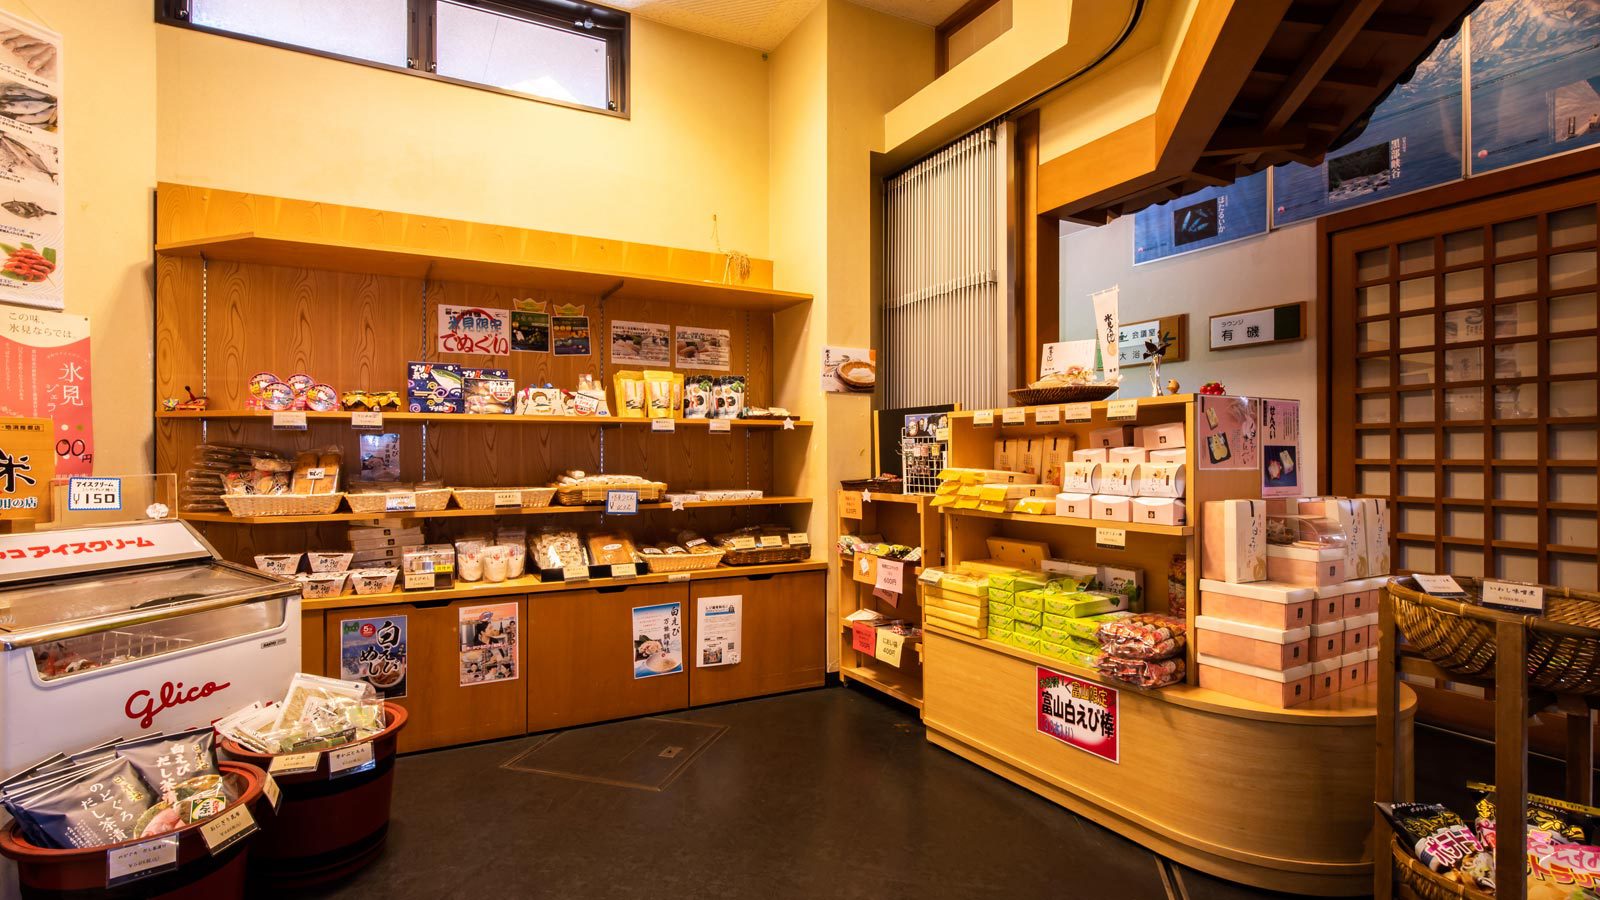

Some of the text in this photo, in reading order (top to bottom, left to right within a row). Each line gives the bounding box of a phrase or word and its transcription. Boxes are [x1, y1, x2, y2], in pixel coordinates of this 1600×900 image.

[1391, 139, 1400, 179] 黒部峡谷
[1132, 328, 1156, 340] 会議室
[1221, 319, 1244, 327] ラウンジ
[58, 362, 84, 406] 氷見
[28, 536, 155, 559] アイスクリーム
[671, 606, 681, 637] 白えび
[376, 620, 401, 674] 白えび
[125, 682, 231, 729] Glico
[1041, 690, 1115, 738] 富山白えび棒
[89, 783, 134, 823] のどぐろ
